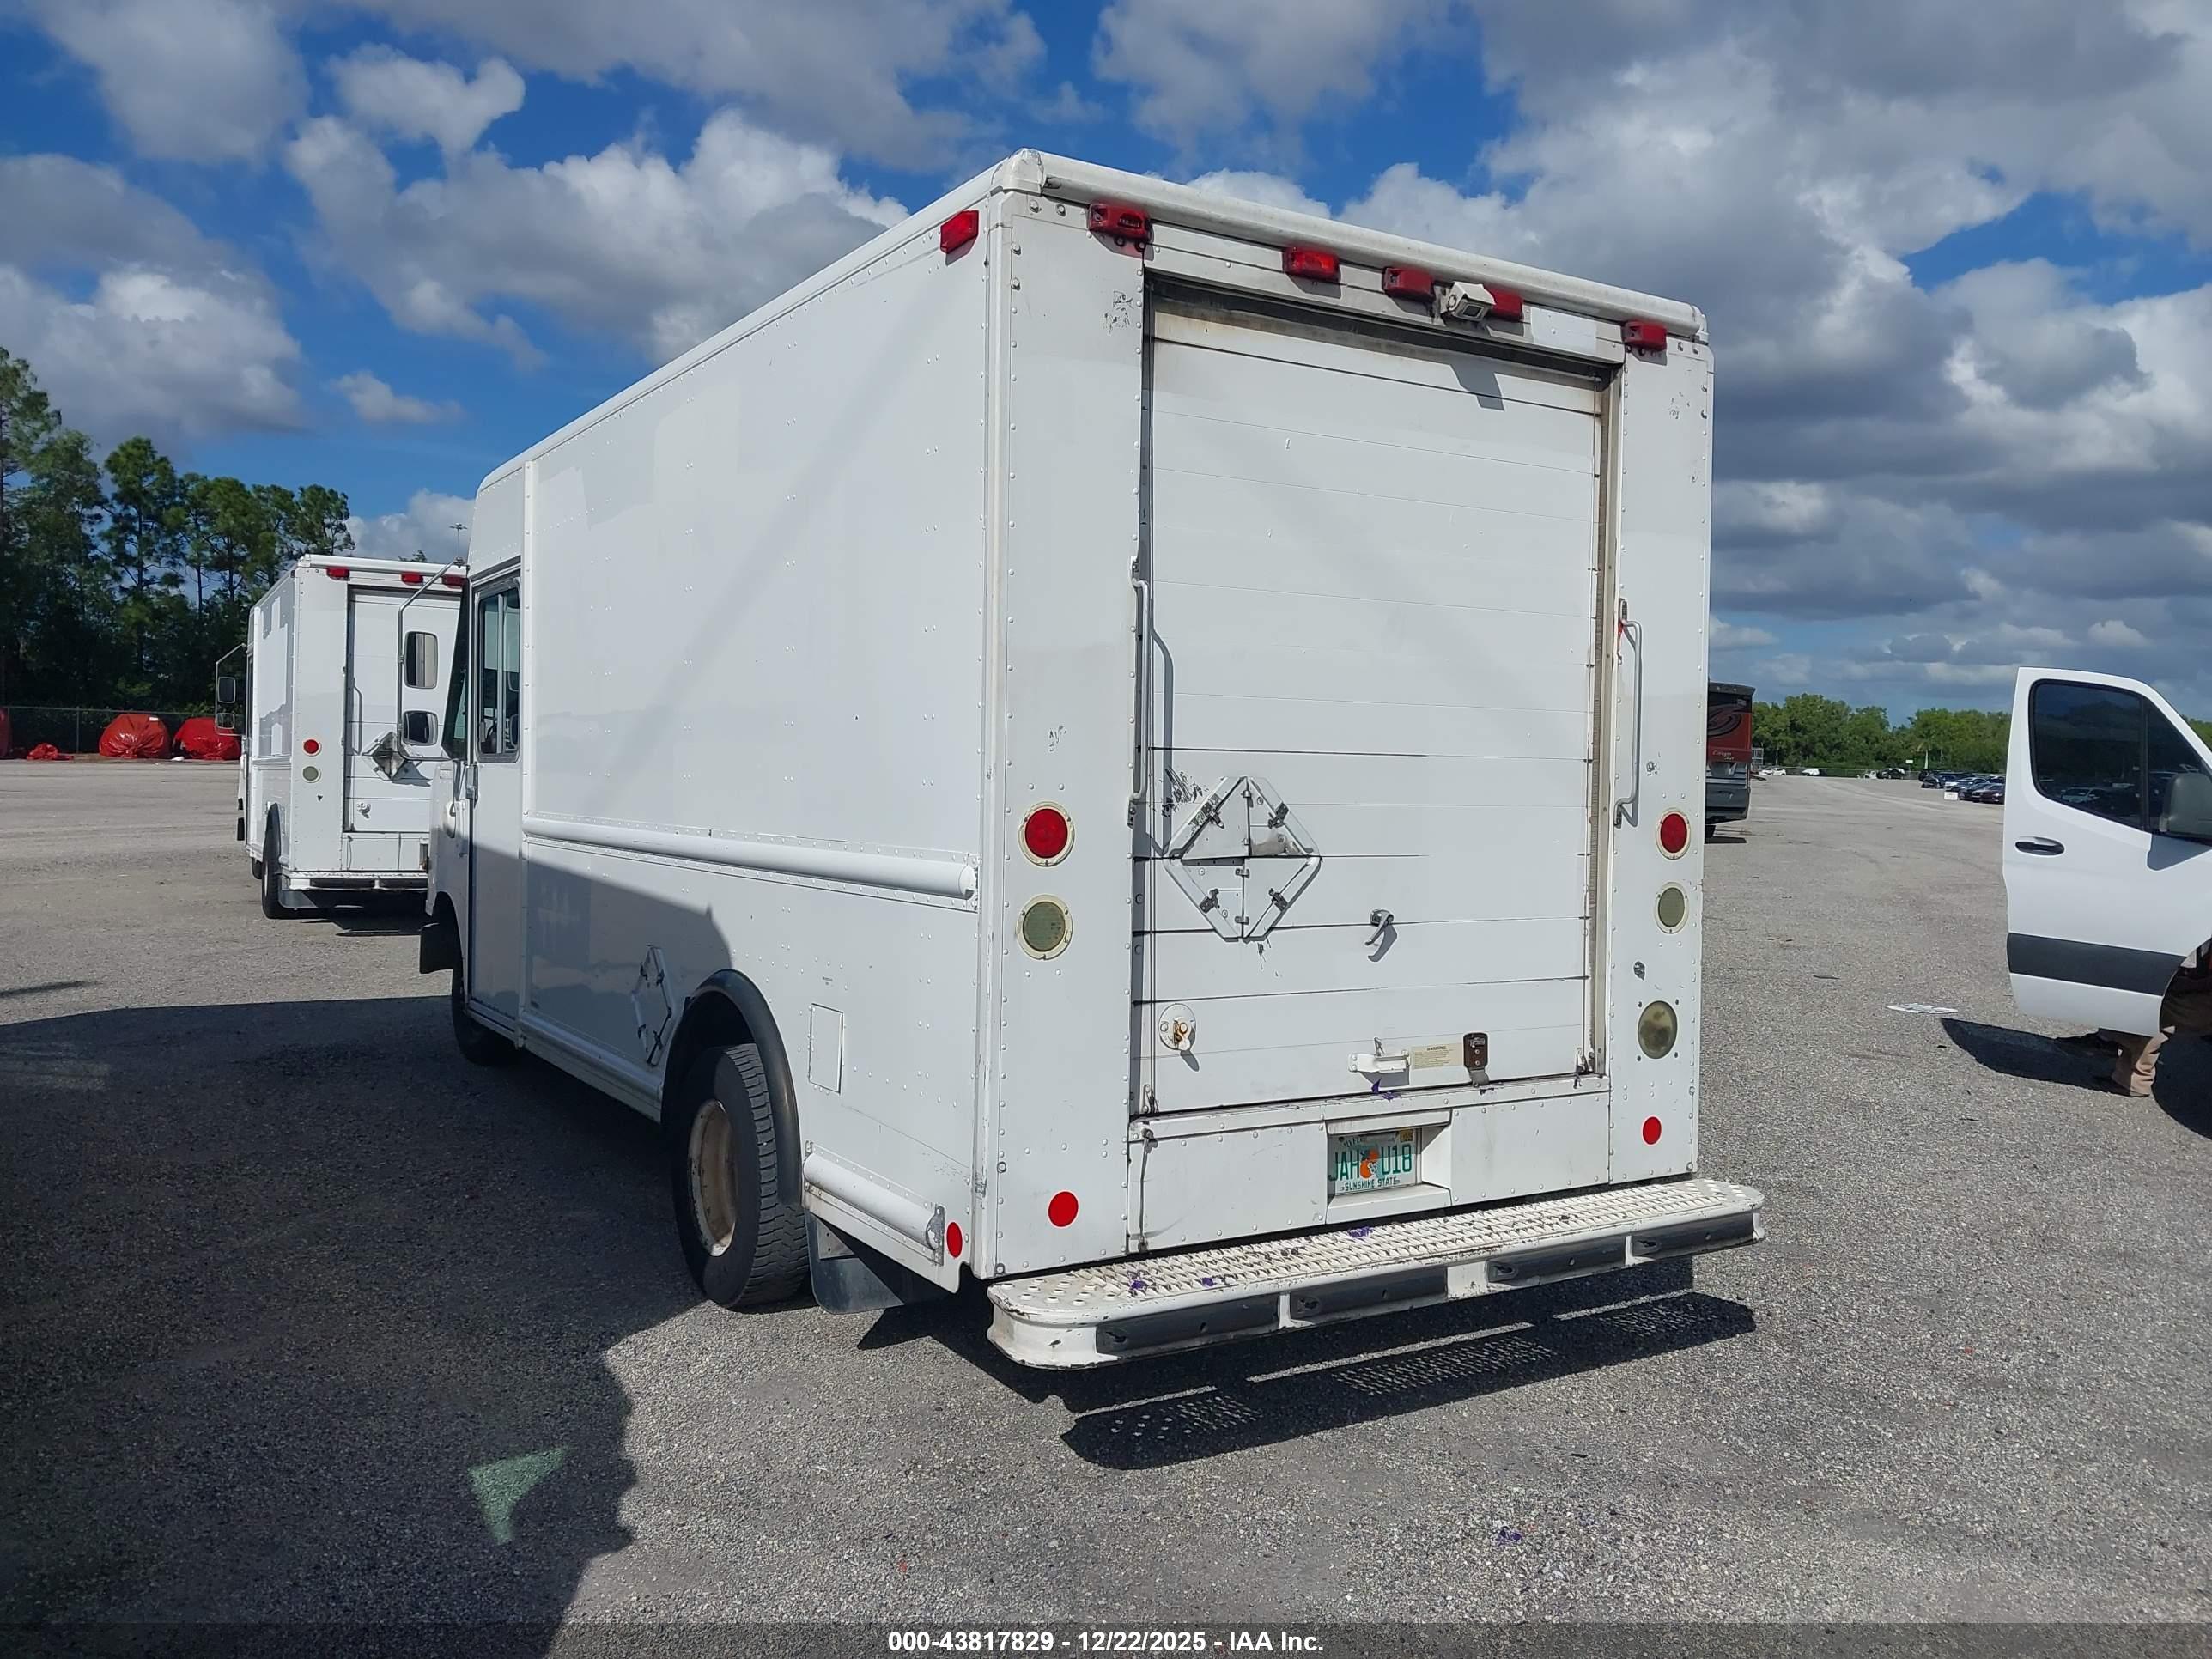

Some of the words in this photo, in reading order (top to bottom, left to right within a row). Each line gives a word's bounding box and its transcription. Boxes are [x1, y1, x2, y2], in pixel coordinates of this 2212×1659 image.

[1328, 1149, 1360, 1182] JAH
[1381, 1143, 1413, 1175] U18
[1345, 1178, 1375, 1191] SUNSHINE
[1377, 1176, 1397, 1187] STATE
